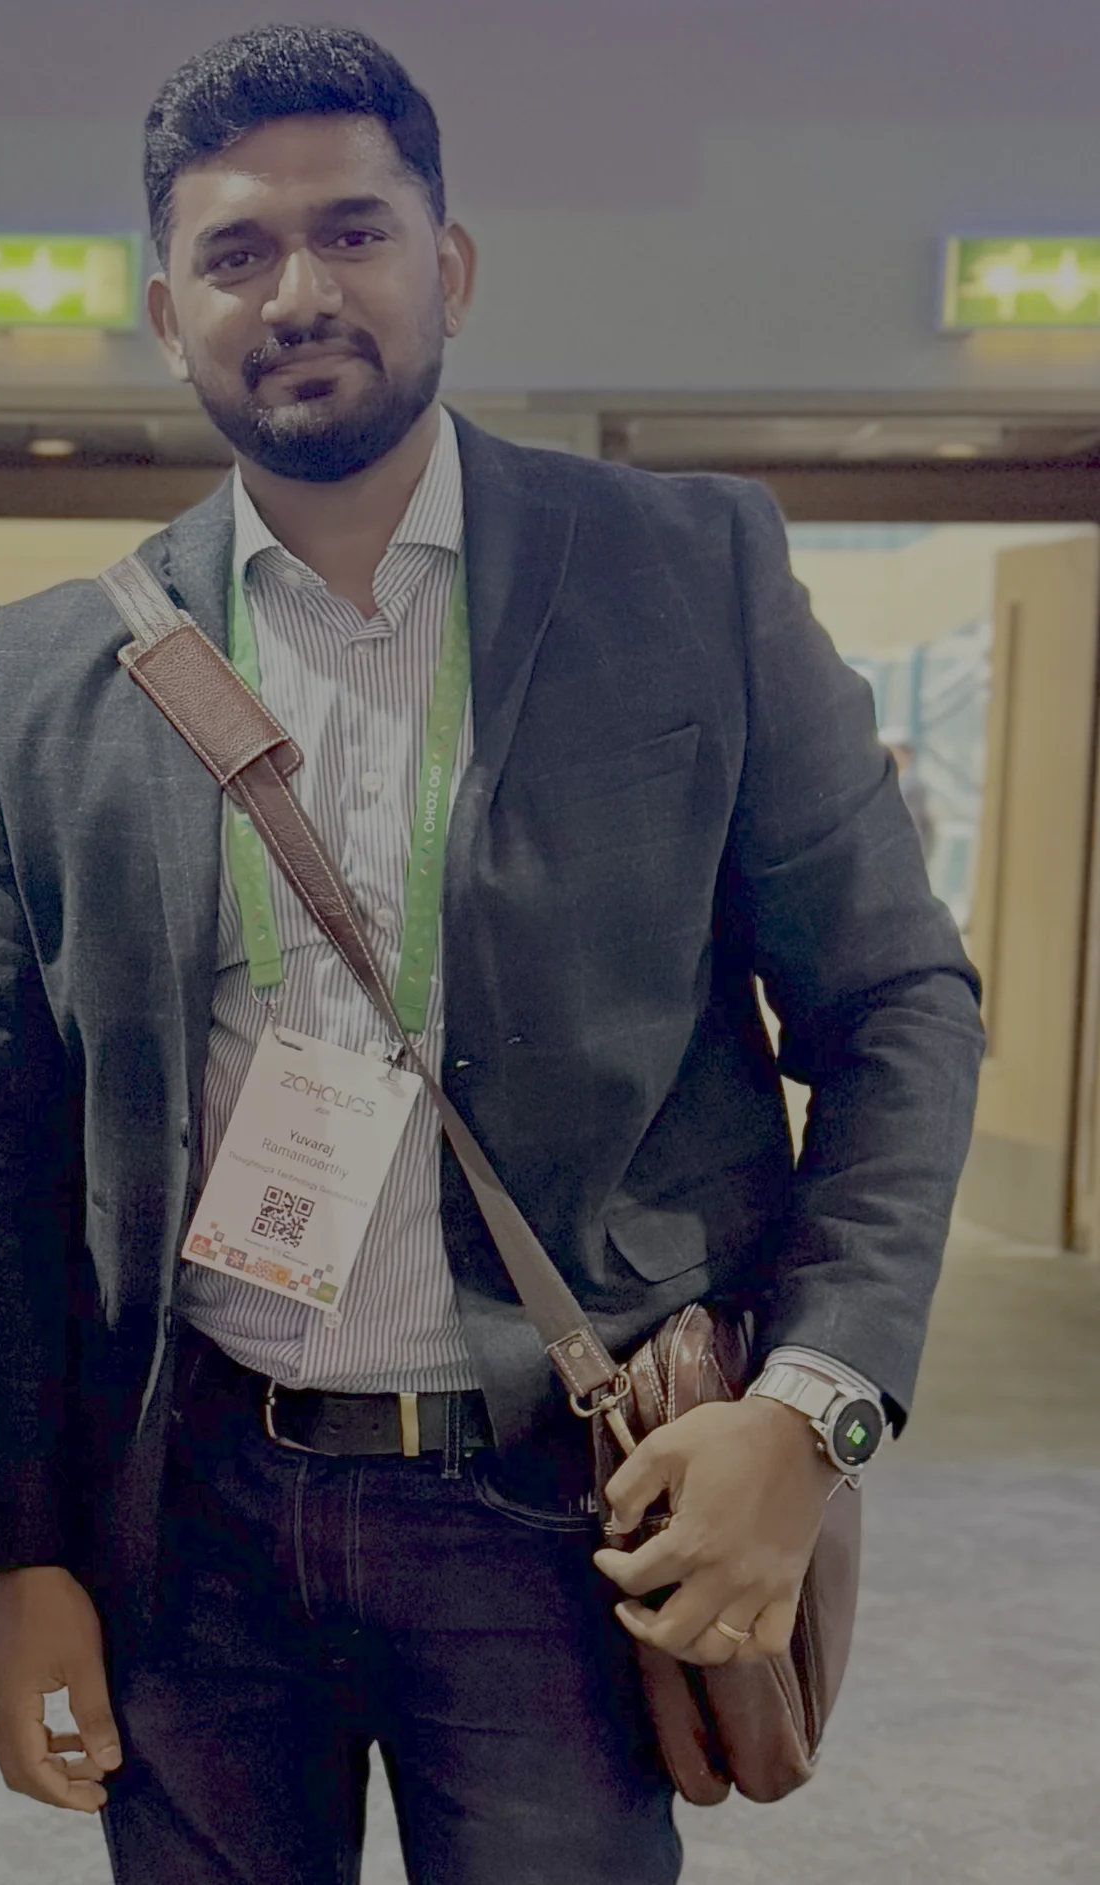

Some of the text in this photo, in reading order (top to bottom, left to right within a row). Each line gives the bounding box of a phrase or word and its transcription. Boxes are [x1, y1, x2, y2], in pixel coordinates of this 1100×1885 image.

[424, 765, 442, 833] GO ZOHO
[280, 1070, 377, 1118] ZOHOLICS
[261, 1137, 350, 1181] Ramamoorthy
[290, 1129, 336, 1158] Yuvaraj
